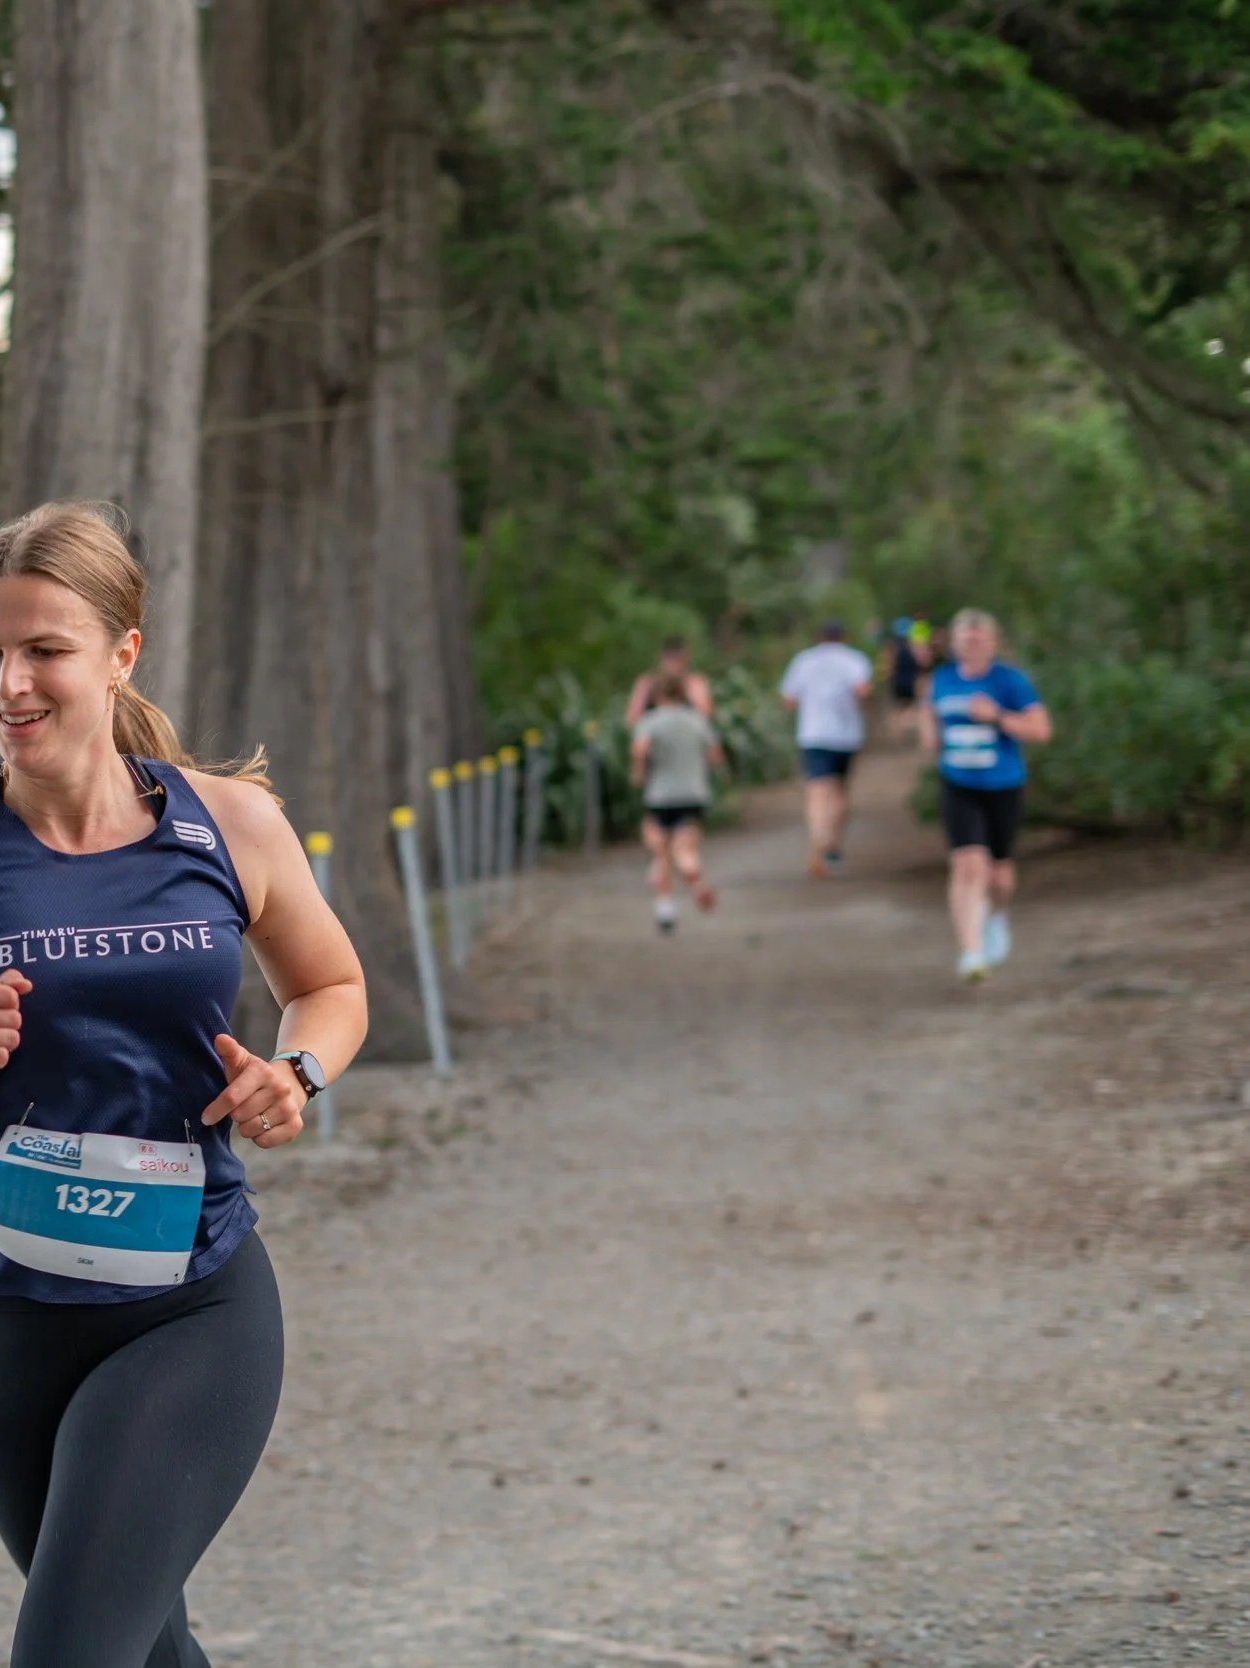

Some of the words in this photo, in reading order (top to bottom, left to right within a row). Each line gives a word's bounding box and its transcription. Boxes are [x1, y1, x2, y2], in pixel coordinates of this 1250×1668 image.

[21, 926, 75, 940] TIMARU
[20, 1136, 83, 1158] Coastal
[139, 1158, 189, 1173] saikou
[55, 1183, 136, 1217] 1327
